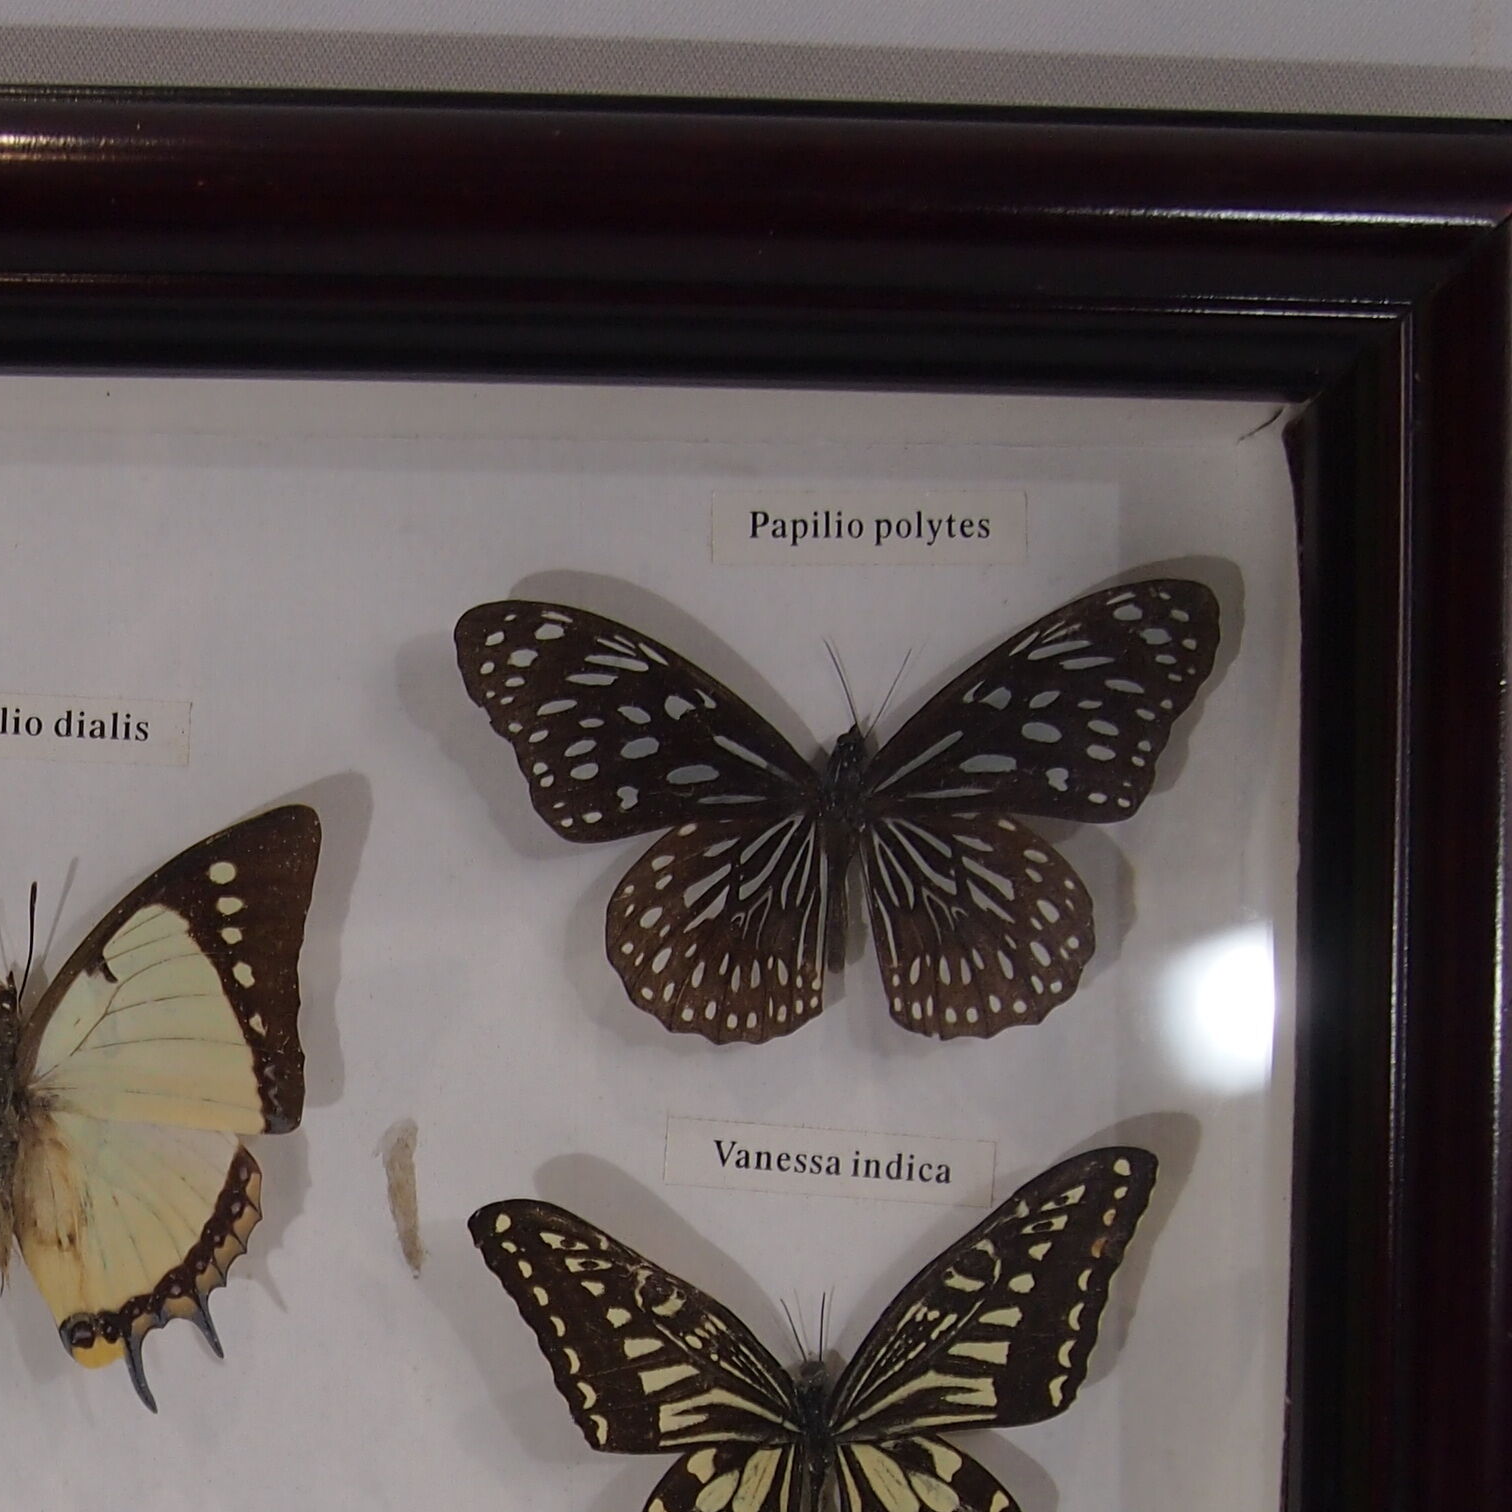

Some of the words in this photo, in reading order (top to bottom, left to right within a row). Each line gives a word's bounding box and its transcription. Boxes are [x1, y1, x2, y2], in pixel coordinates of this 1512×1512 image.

[749, 510, 864, 547] Papilio
[874, 510, 991, 547] polytes
[53, 709, 149, 742] dialis
[713, 1139, 841, 1176] Vanessa
[850, 1149, 951, 1185] indica
